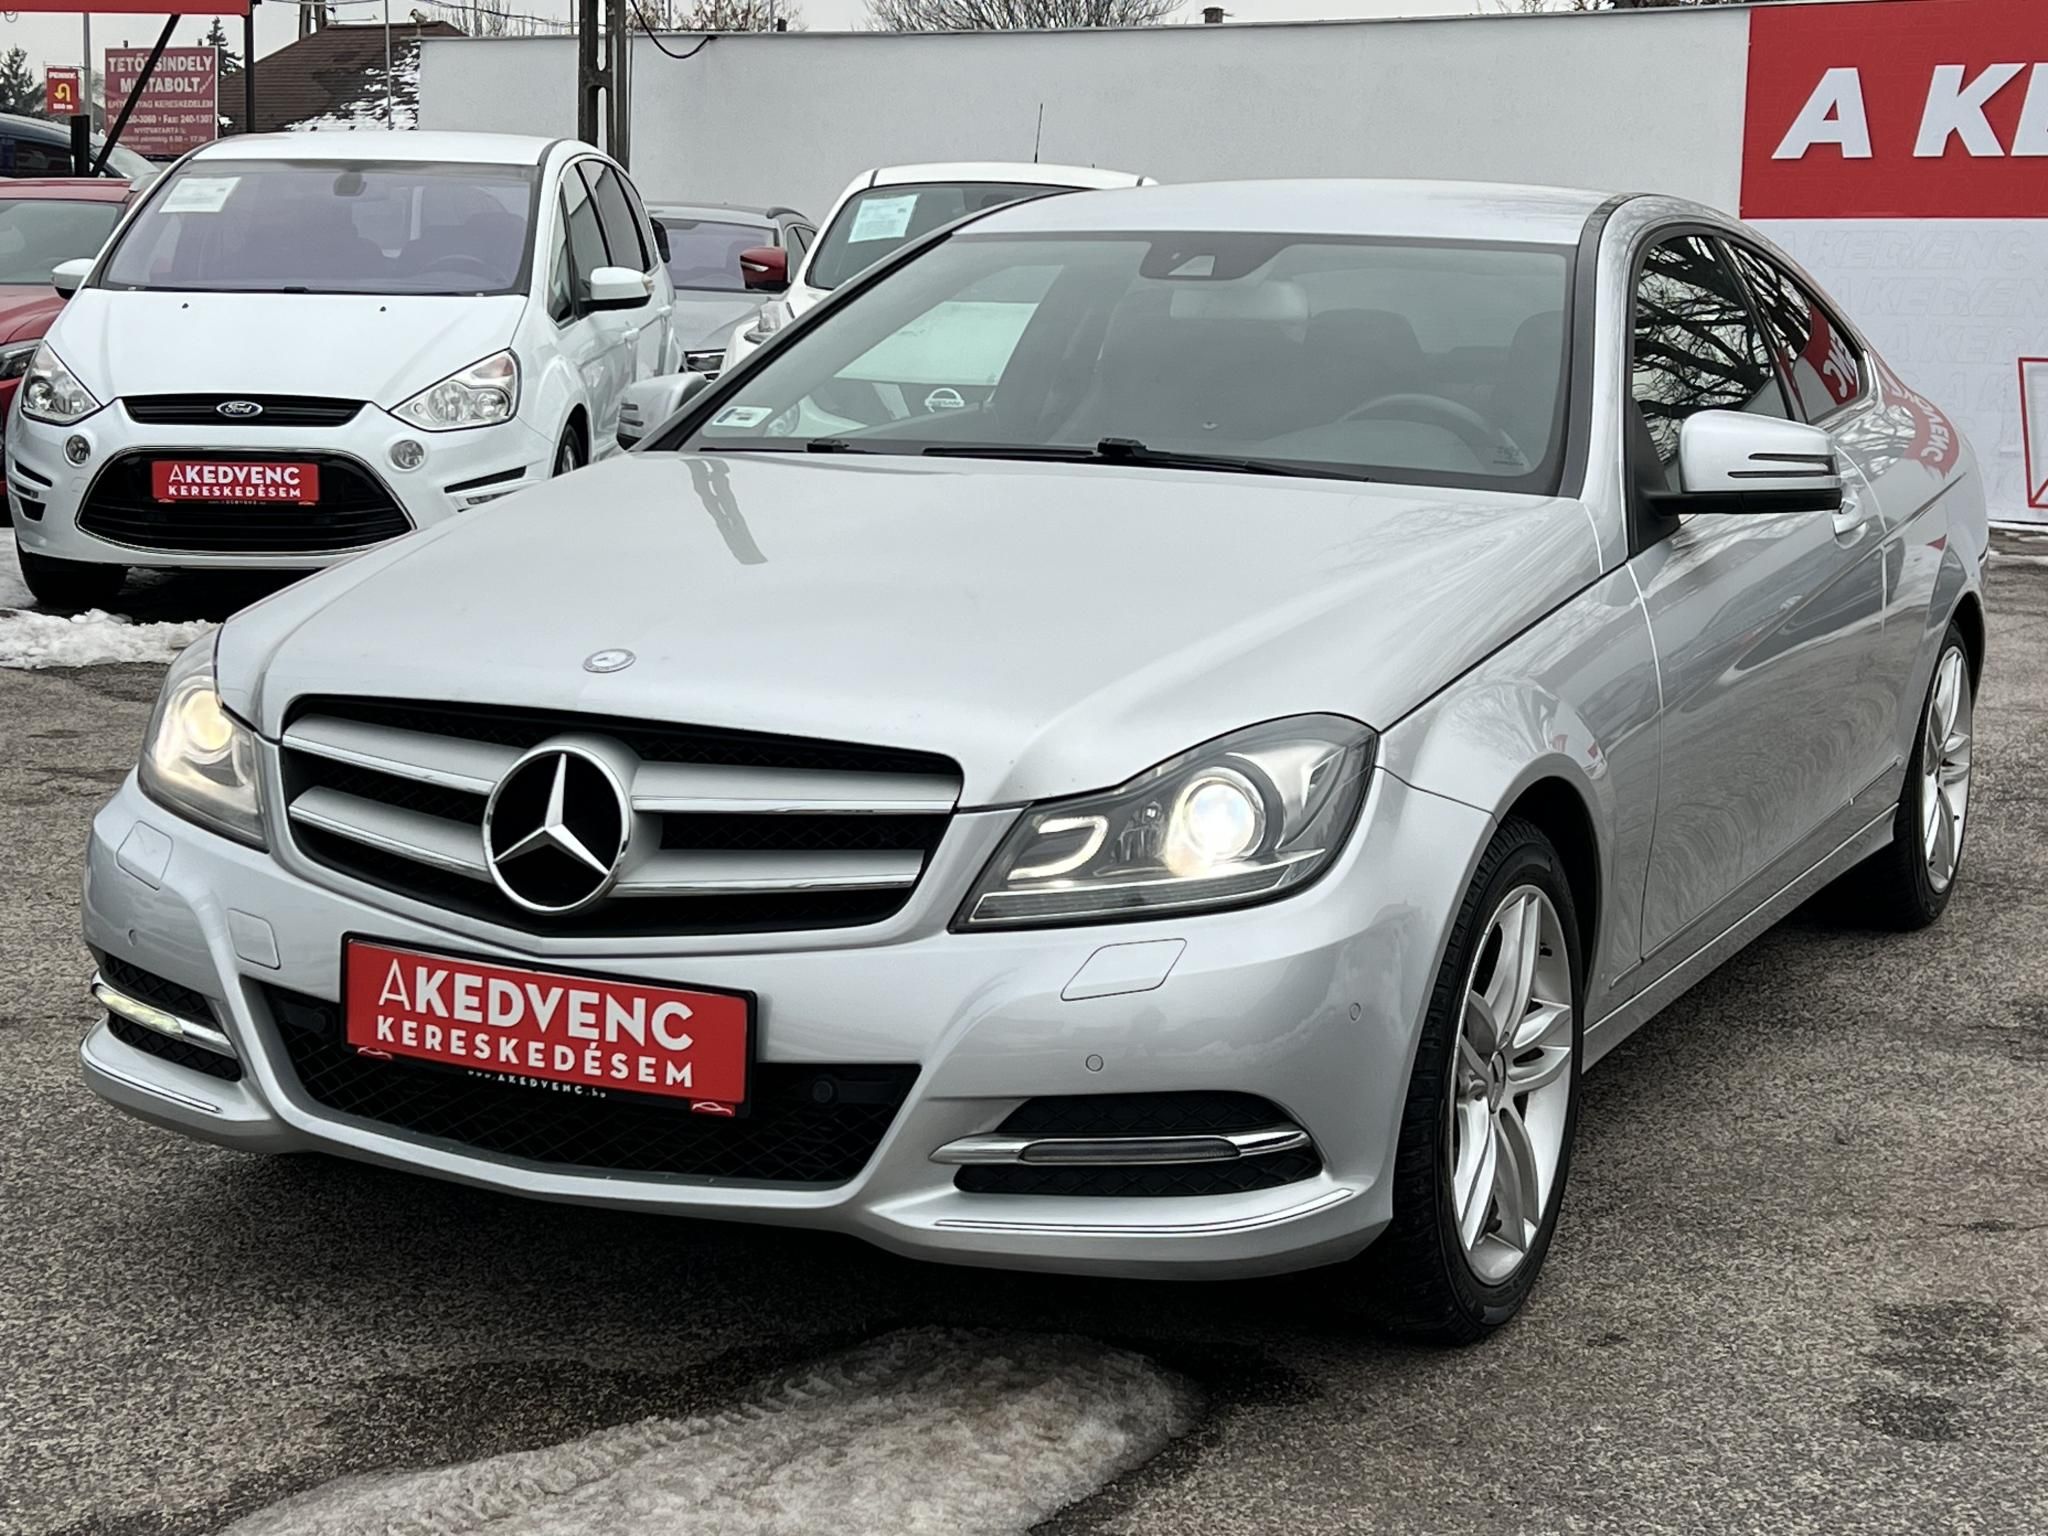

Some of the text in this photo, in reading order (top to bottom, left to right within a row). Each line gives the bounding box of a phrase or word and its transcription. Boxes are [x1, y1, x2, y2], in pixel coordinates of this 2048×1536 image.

[1771, 66, 1873, 159] A
[168, 484, 301, 498] KERESKEDÉSEM
[377, 1014, 693, 1088] KERESKEDÉSEM
